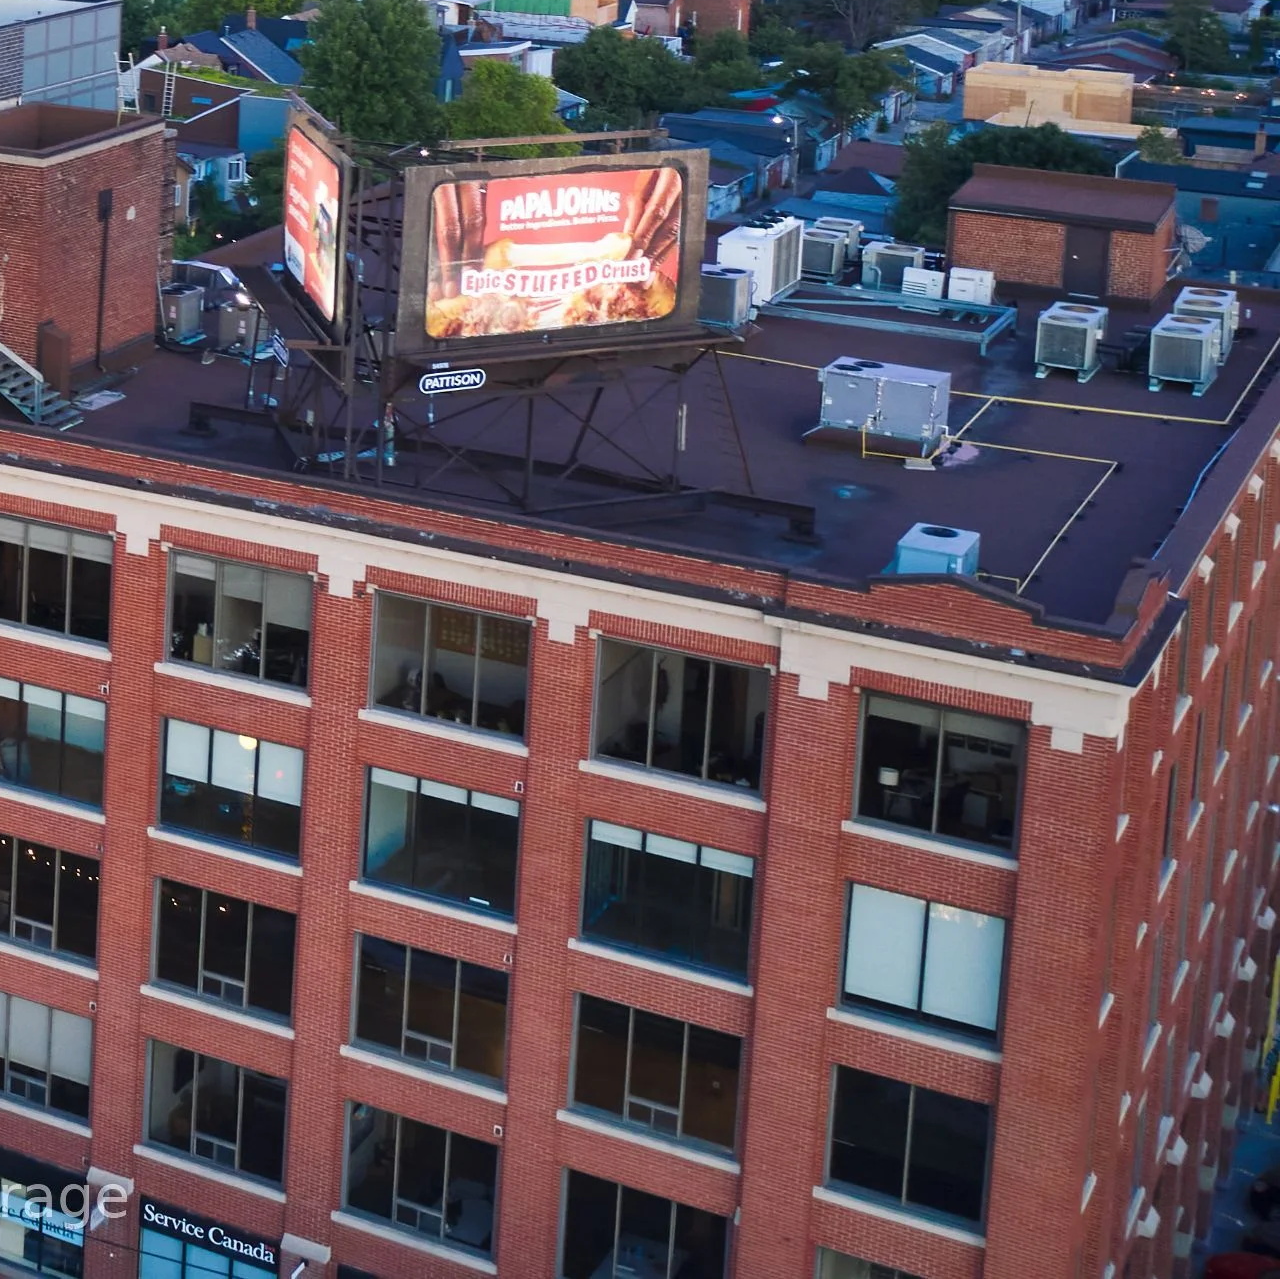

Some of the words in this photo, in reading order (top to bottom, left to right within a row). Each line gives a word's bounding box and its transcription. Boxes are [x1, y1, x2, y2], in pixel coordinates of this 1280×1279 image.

[500, 190, 553, 221] PAPA
[552, 187, 621, 218] JOHNS
[465, 274, 500, 292] Epic
[503, 265, 597, 293] STUFFED
[601, 262, 645, 280] Crust
[425, 373, 481, 390] PATTISON
[143, 1203, 205, 1239] Service
[207, 1226, 276, 1265] Canada
